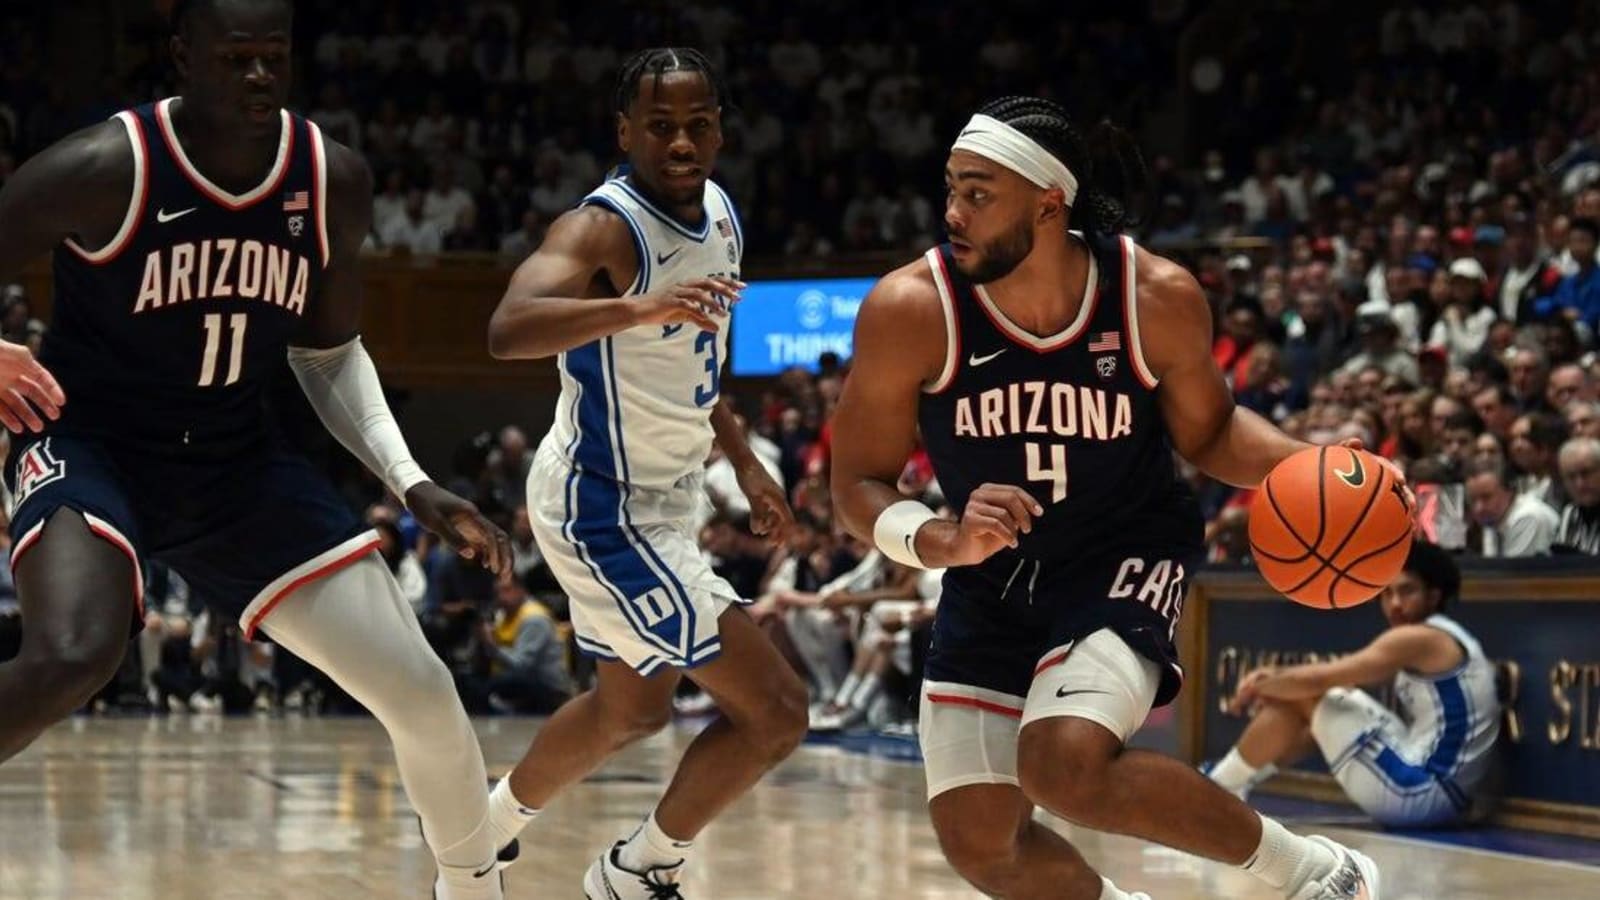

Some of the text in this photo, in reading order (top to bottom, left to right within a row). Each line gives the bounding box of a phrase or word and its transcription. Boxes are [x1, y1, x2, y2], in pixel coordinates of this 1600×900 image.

[133, 238, 309, 316] ARIZONA
[198, 313, 247, 387] 11
[694, 330, 719, 408] 3
[954, 380, 1133, 441] ARIZONA
[1025, 442, 1068, 503] 4
[1548, 659, 1600, 750] ST
